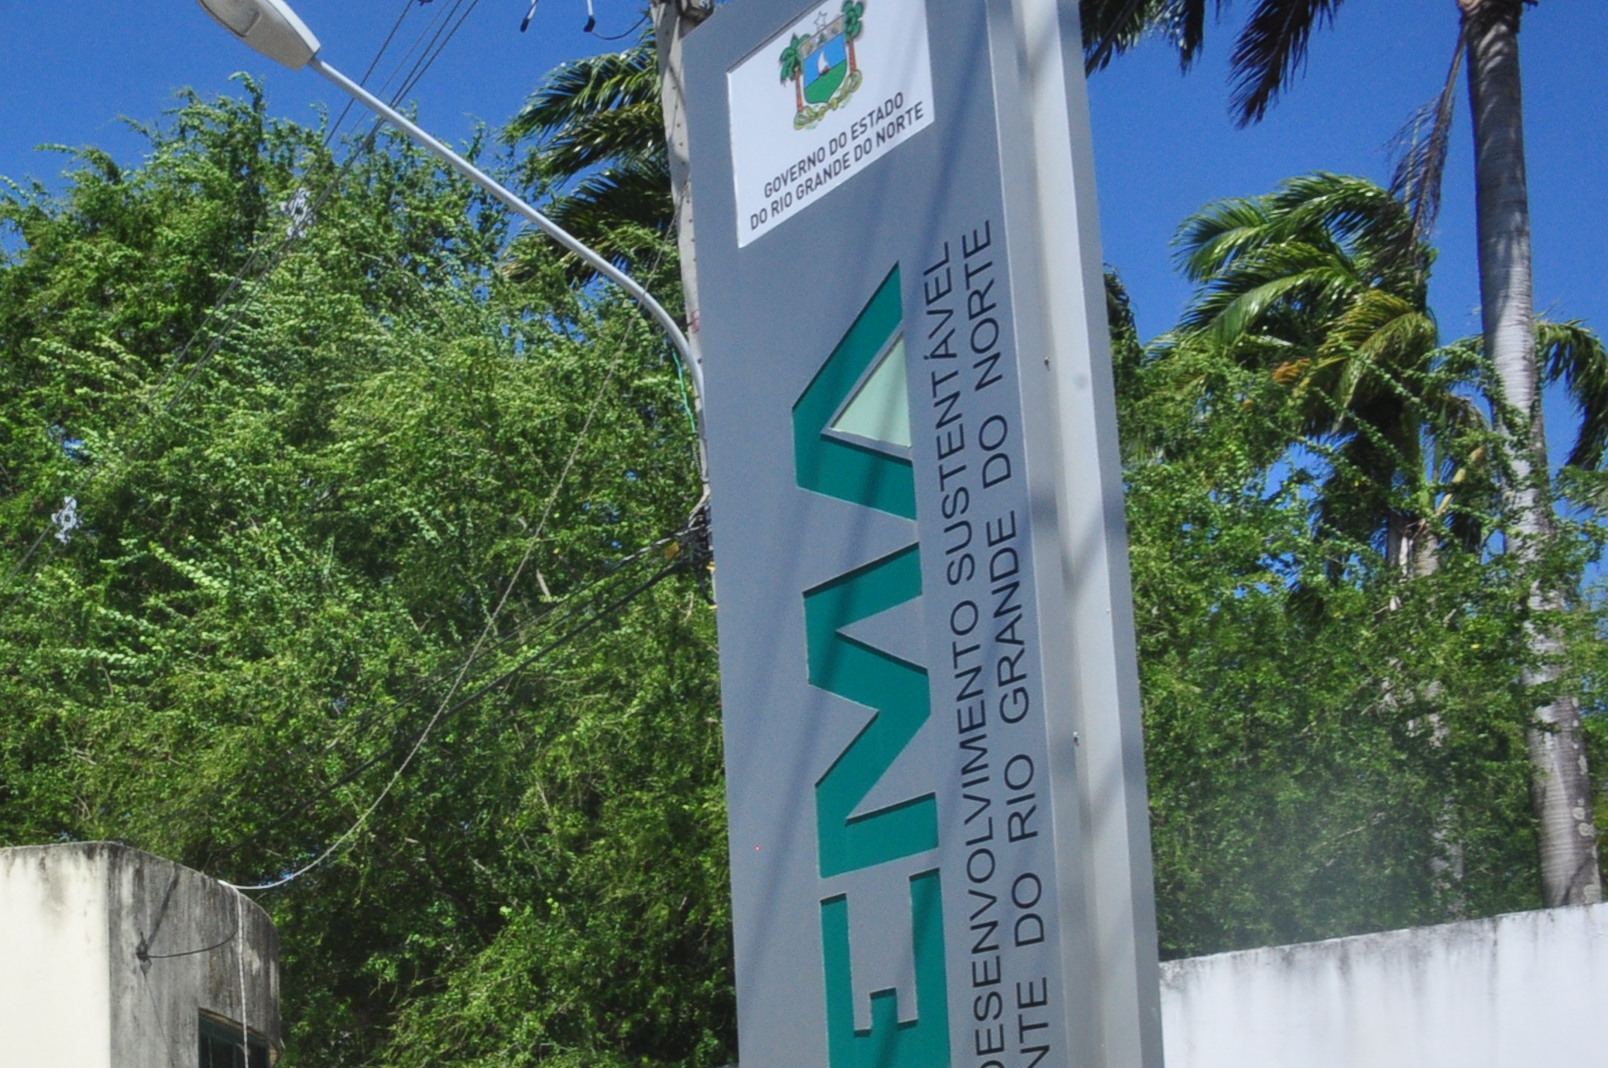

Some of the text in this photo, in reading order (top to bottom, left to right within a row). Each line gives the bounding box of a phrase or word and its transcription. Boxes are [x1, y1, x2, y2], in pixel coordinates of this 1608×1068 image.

[749, 101, 924, 231] DO RIO GRANDE DO NORTE
[764, 91, 904, 199] GOVERNO DO ESTADO
[961, 219, 1004, 392] NORTE
[923, 240, 976, 586] SUSTENTÁVEL
[977, 413, 1013, 489] DO
[985, 510, 1030, 725] GRANDE
[1003, 753, 1039, 844] RIO
[1010, 872, 1045, 948] DO
